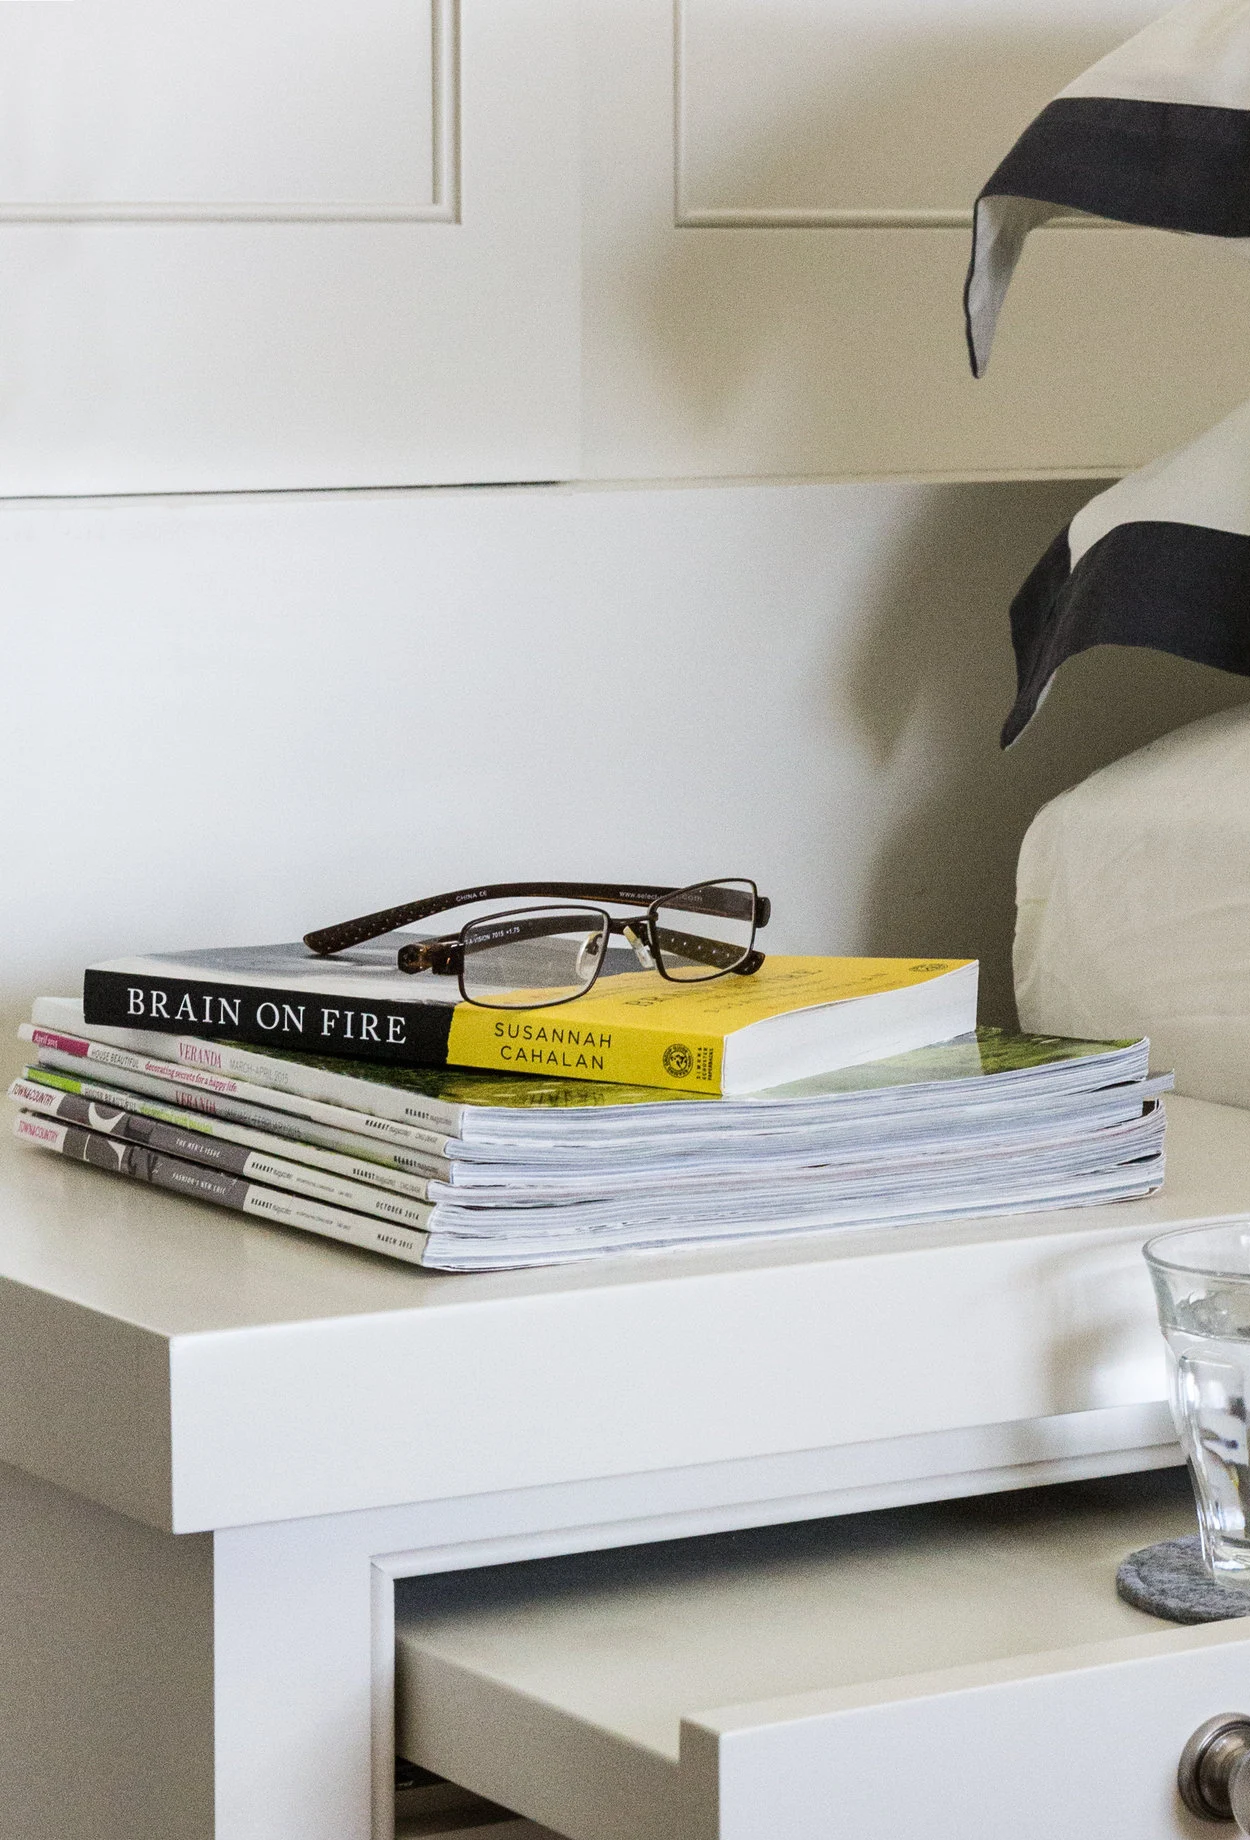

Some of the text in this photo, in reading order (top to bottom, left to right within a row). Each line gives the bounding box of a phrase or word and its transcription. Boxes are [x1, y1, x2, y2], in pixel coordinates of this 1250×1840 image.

[127, 987, 408, 1044] BRAIN ON FIRE
[494, 1022, 612, 1049] SUSANNAH
[178, 1042, 222, 1069] VERANDA
[500, 1046, 604, 1070] CAHALAN
[145, 1061, 174, 1078] decorating
[174, 1069, 195, 1082] secrets
[195, 1073, 205, 1084] for
[208, 1077, 226, 1092] happy
[376, 1201, 403, 1216] OCTOBER
[377, 1233, 397, 1246] MARCH
